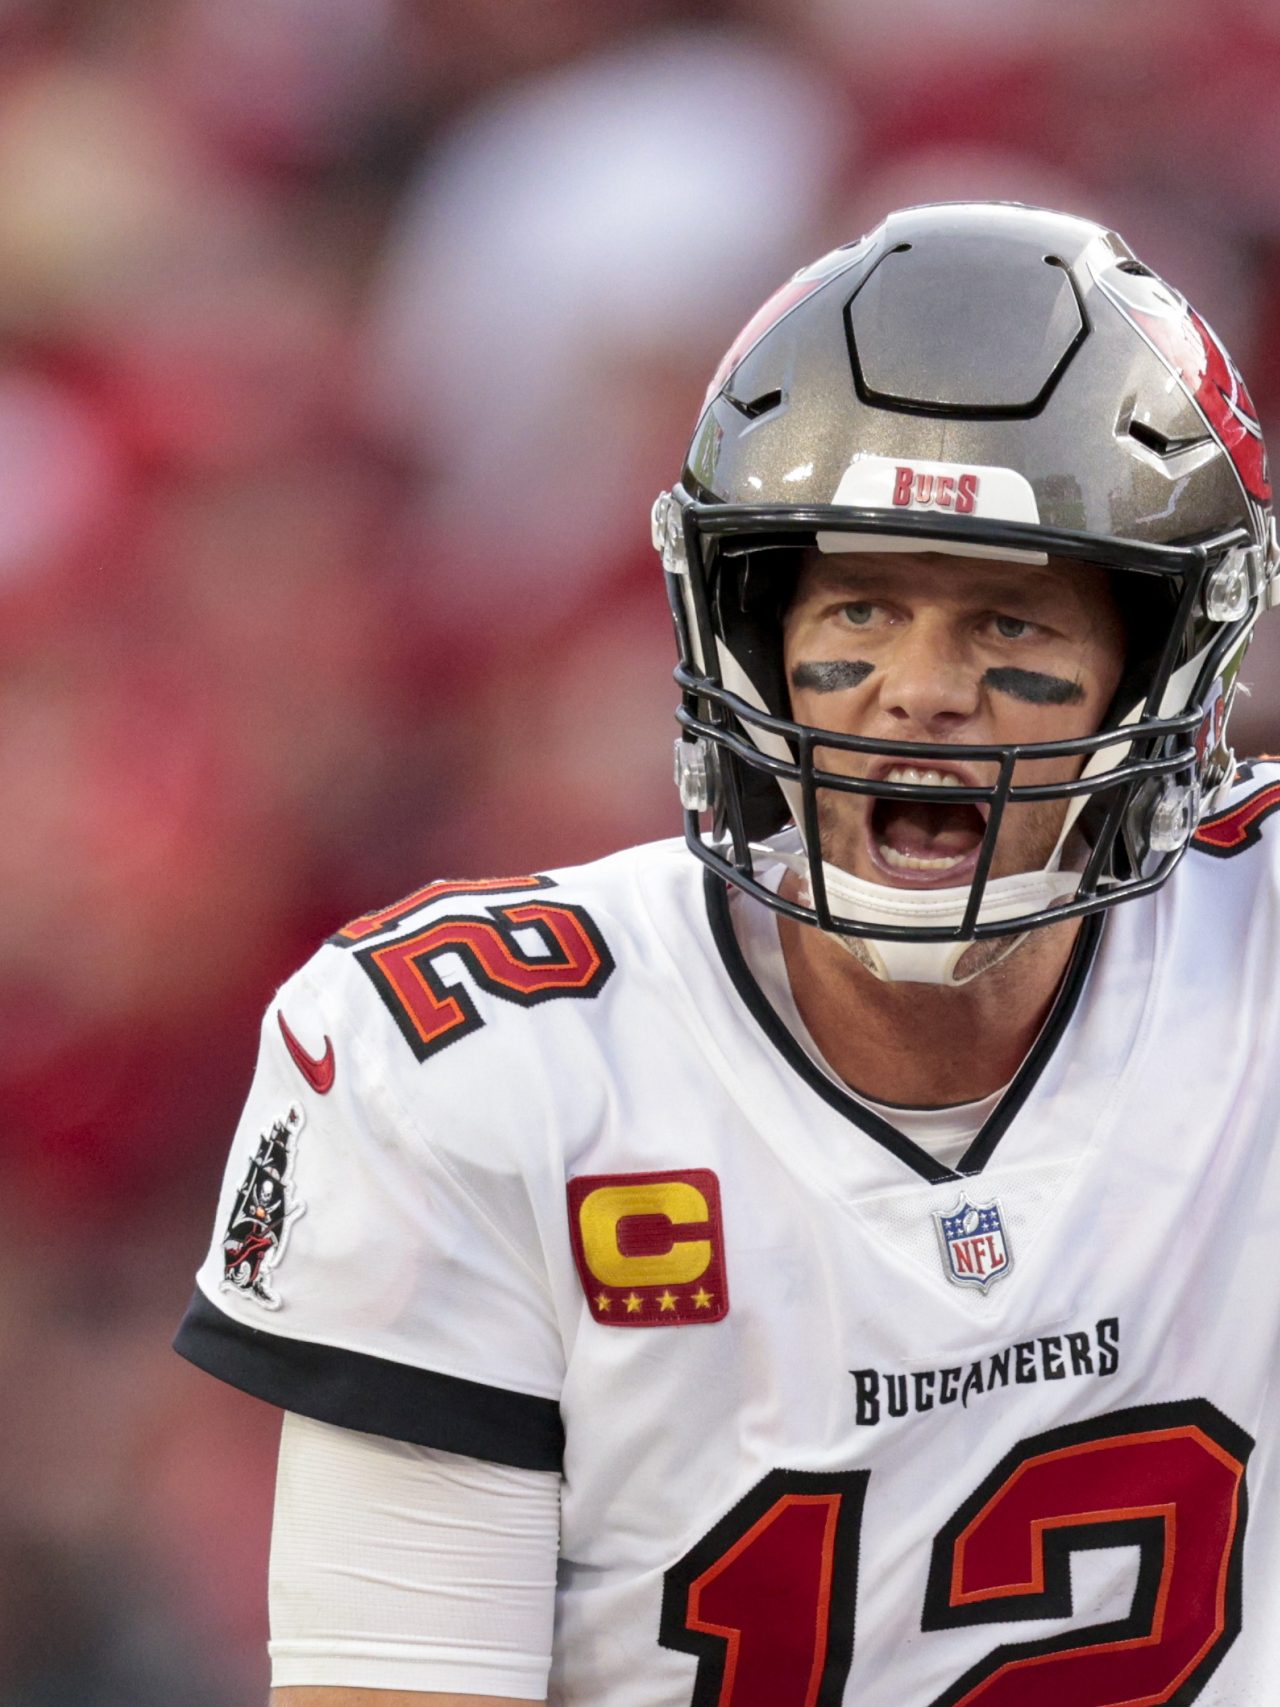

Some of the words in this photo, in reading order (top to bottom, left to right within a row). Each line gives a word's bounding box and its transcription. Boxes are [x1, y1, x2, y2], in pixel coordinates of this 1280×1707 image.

[892, 466, 978, 513] BUCS
[580, 1182, 712, 1288] C
[952, 1235, 1004, 1275] NFL
[849, 1317, 1119, 1426] BUCCANEERS
[659, 1398, 1255, 1707] 12
